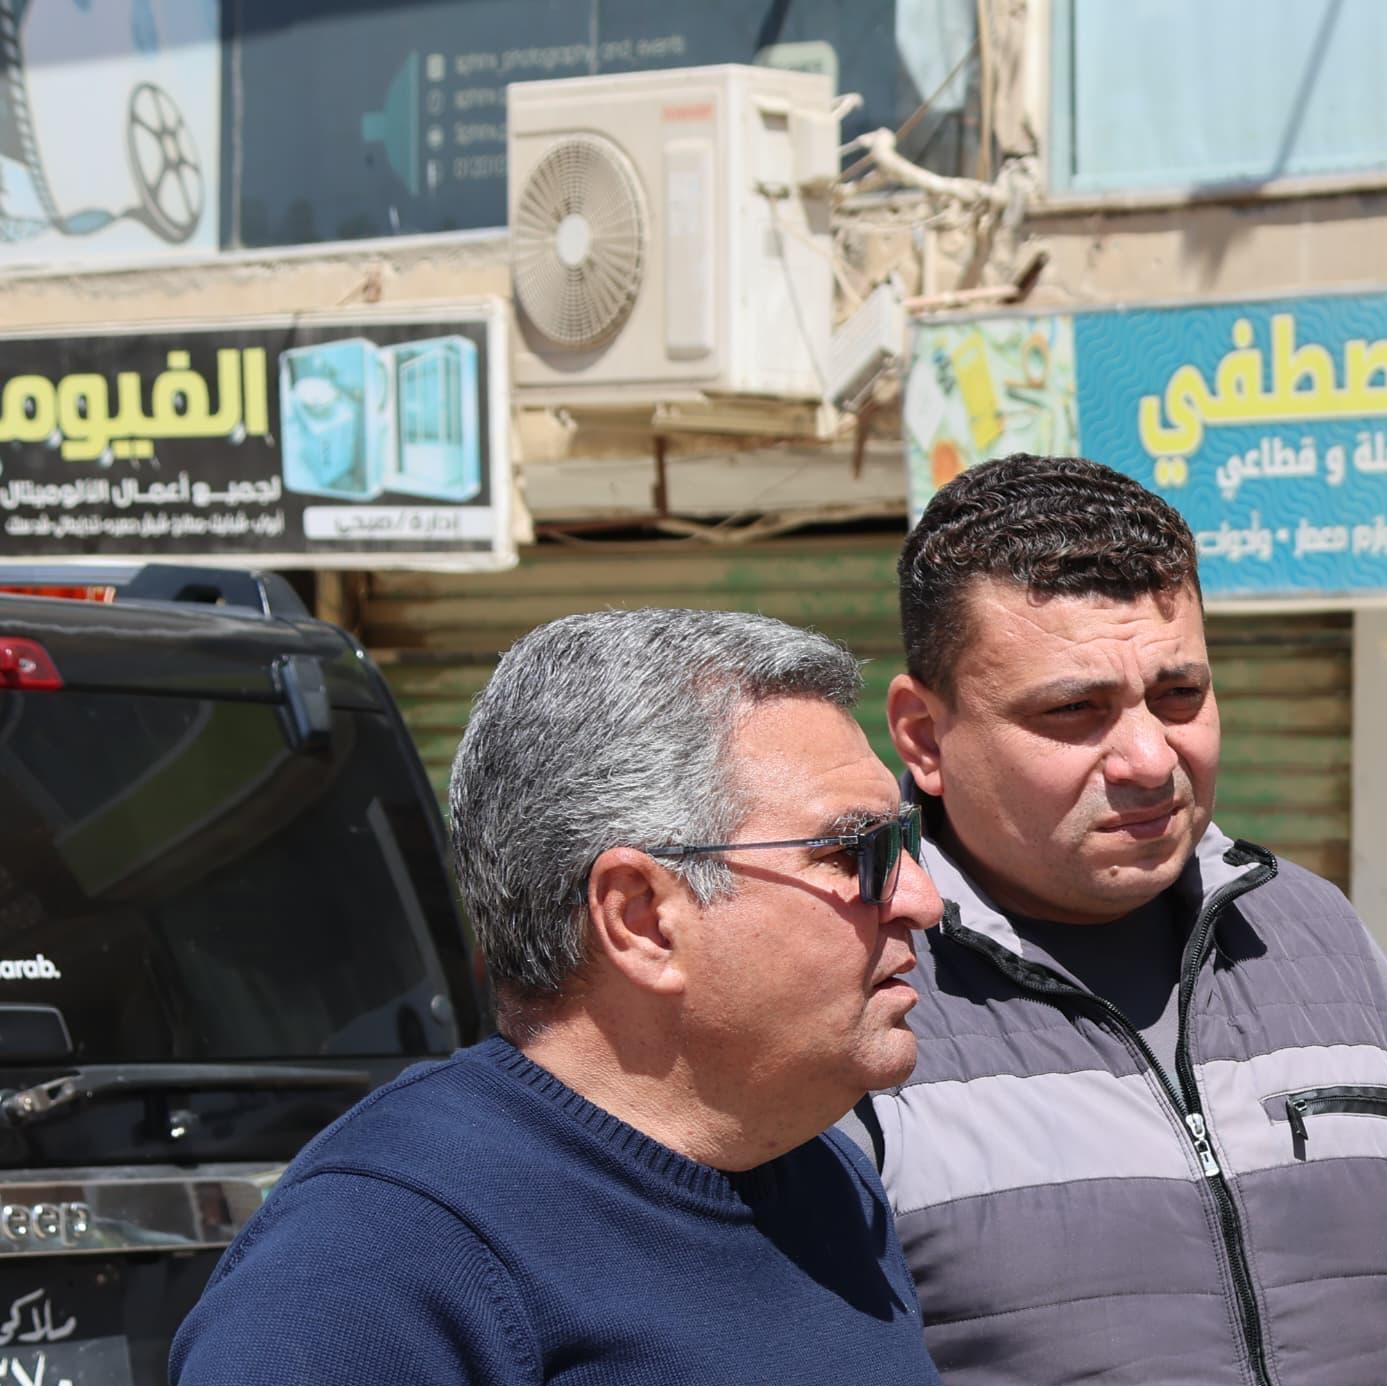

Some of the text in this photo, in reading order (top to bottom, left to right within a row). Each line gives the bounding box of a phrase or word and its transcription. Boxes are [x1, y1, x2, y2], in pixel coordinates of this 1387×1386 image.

[0, 346, 269, 462] الفيوم
[1216, 436, 1318, 498] قطاعي
[1325, 443, 1345, 486] و
